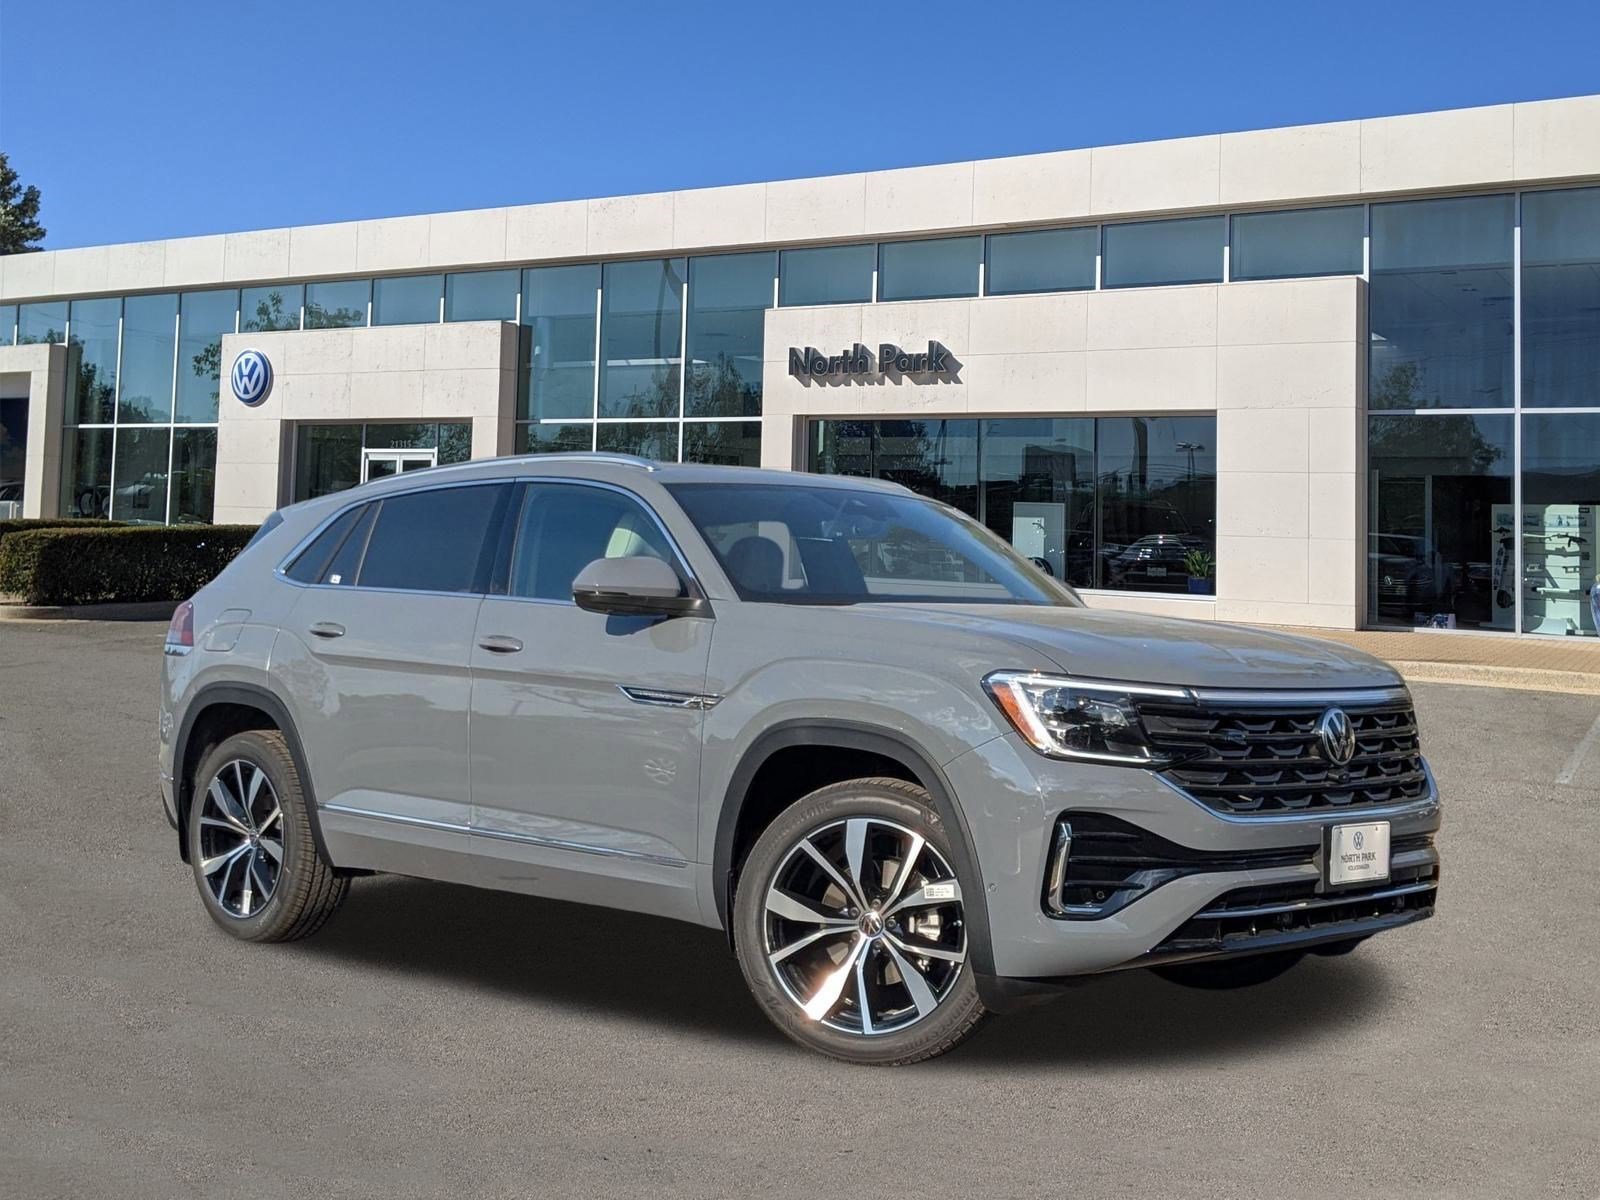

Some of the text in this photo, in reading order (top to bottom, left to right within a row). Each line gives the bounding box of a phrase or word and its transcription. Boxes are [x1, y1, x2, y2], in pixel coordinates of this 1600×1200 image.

[789, 340, 947, 376] North Park
[1361, 851, 1376, 862] PARK
